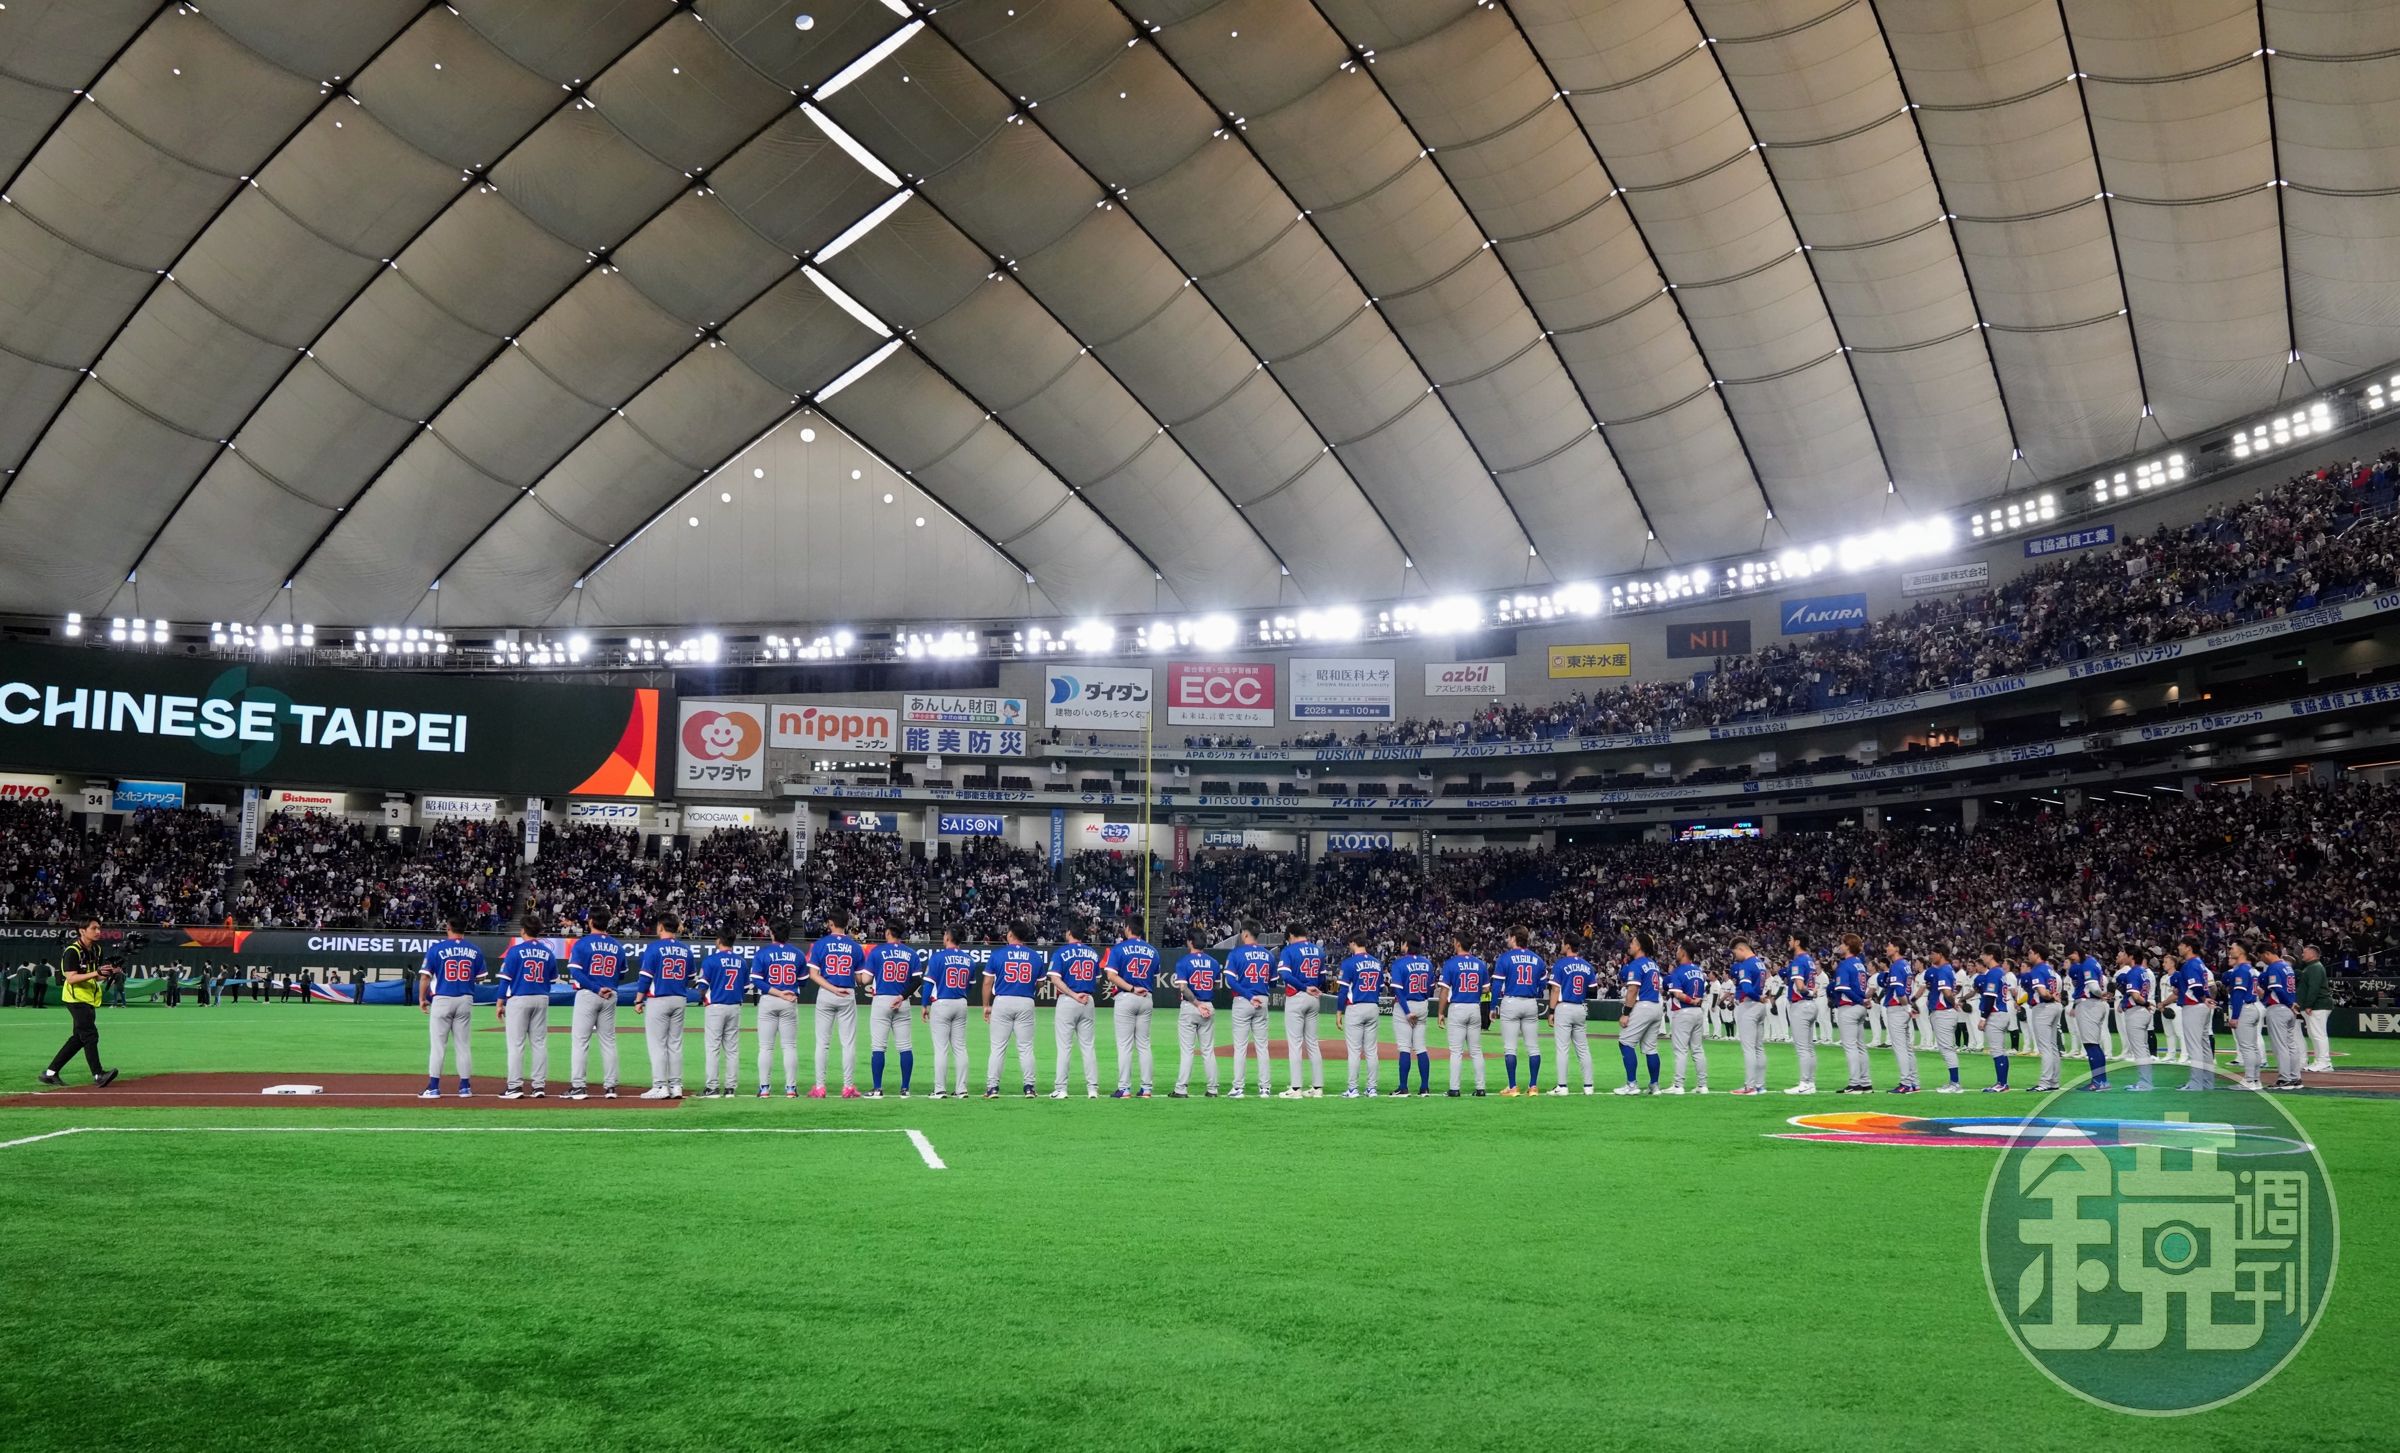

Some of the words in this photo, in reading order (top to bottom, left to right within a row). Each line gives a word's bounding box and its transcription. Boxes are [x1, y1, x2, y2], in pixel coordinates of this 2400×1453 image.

[1566, 653, 1627, 669] 東洋水産
[1316, 669, 1390, 681] 昭和医科大学
[1441, 665, 1489, 683] azbil
[1084, 681, 1149, 702] ダイダン
[1180, 675, 1262, 705] ECC
[1435, 683, 1496, 694] アズビル株式会社
[911, 697, 997, 714] あんしん財団
[0, 682, 275, 742] CHINESE
[290, 703, 467, 753] TAIPEI
[779, 708, 889, 742] nippn
[855, 739, 888, 750] ニップン
[905, 727, 1022, 755] 能美防災
[1315, 749, 1366, 761] DUSKIN
[1372, 748, 1423, 760] DUSKIN
[689, 763, 752, 782] シマダヤ
[88, 795, 103, 806] 34
[114, 791, 182, 804] 文化シャッター
[282, 792, 332, 804] Bishamon
[425, 800, 492, 813] 昭和医科大学
[391, 808, 398, 818] 3
[571, 804, 638, 817] ニッテイライフ
[687, 812, 739, 823] YOKOGAWA
[664, 818, 670, 827] 1
[941, 818, 998, 832] SAISON
[795, 821, 807, 861] 三機工業
[1205, 833, 1242, 844] JR貨物
[1330, 834, 1390, 850] TOTO
[308, 936, 395, 952] CHINESE
[444, 959, 472, 982] 66
[523, 960, 545, 983] 31
[589, 953, 618, 978] 28
[661, 957, 686, 980] 23
[768, 963, 797, 985] 96
[825, 954, 853, 976] 92
[882, 960, 909, 983] 88
[1003, 961, 1032, 984] 58
[1069, 960, 1095, 981] 48
[1126, 957, 1152, 979] 47
[1244, 962, 1270, 983] 44
[1299, 957, 1321, 978] 42
[1516, 964, 1533, 985] 11
[724, 969, 738, 990] 7
[945, 967, 970, 989] 60
[1188, 970, 1214, 991] 45
[1358, 971, 1380, 992] 37
[1408, 973, 1429, 994] 20
[1458, 972, 1480, 993] 12
[1572, 975, 1585, 995] 9
